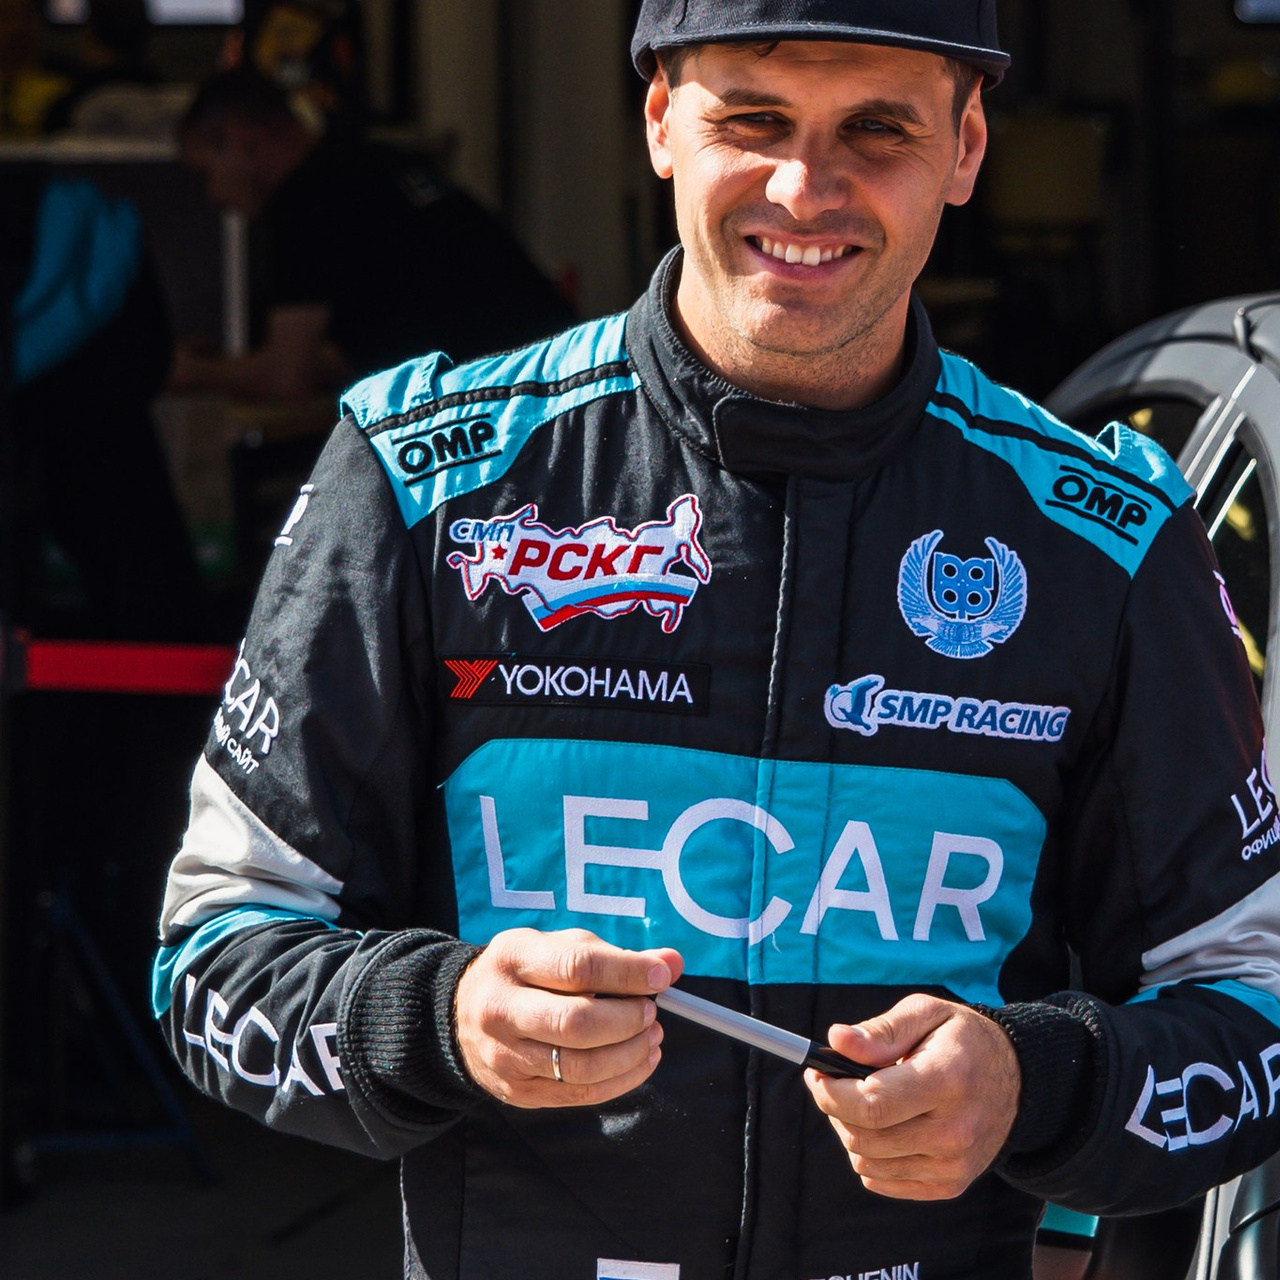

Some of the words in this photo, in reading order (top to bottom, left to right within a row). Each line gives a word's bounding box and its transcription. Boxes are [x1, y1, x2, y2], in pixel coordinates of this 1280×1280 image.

[397, 421, 496, 475] OMP
[1051, 474, 1147, 529] OMP
[452, 519, 516, 543] СМП
[508, 539, 665, 581] РСКГ
[224, 637, 281, 755] CAR
[498, 663, 694, 704] YOKOHAMA
[876, 693, 951, 723] SMP
[956, 703, 1068, 739] RACING
[478, 794, 1005, 947] LECAR
